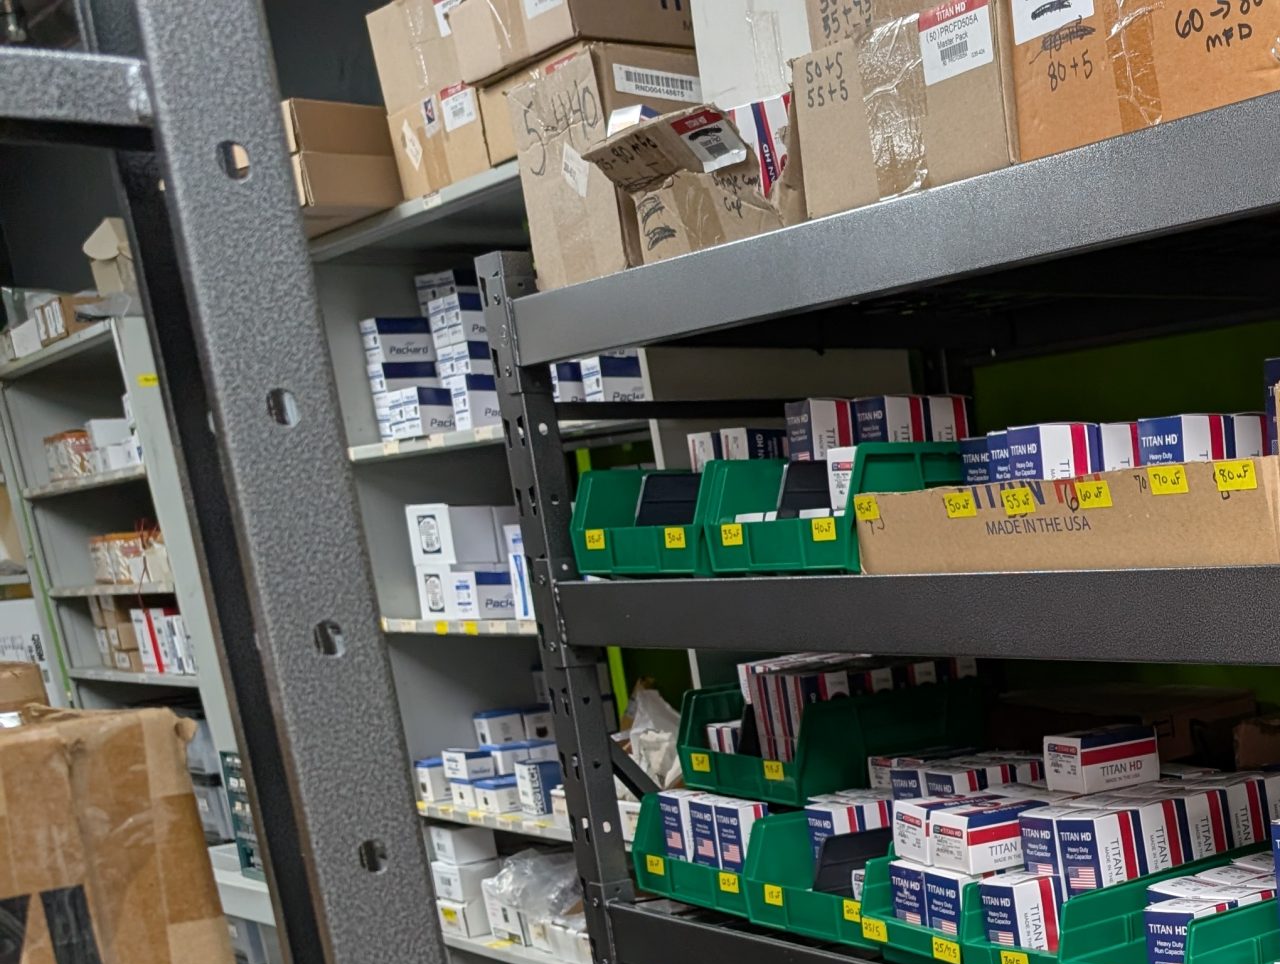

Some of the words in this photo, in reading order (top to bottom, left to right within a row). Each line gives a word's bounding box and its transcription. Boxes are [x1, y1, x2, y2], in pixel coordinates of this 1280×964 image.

[935, 5, 954, 23] TITAN
[953, 1, 967, 18] HD
[1175, 8, 1204, 39] 60
[936, 36, 955, 49] Master
[955, 32, 968, 45] Pack
[1206, 22, 1252, 52] MFD
[805, 52, 844, 84] 50+5
[1048, 49, 1093, 92] 80+5
[808, 79, 849, 108] 55+5
[1141, 436, 1161, 448] TITAN
[1163, 434, 1178, 446] HD
[1154, 472, 1168, 488] 70
[1218, 467, 1233, 482] 80
[986, 520, 1018, 535] MADE
[1022, 519, 1035, 532] IN
[1038, 518, 1062, 531] THE
[1065, 516, 1091, 530] USA
